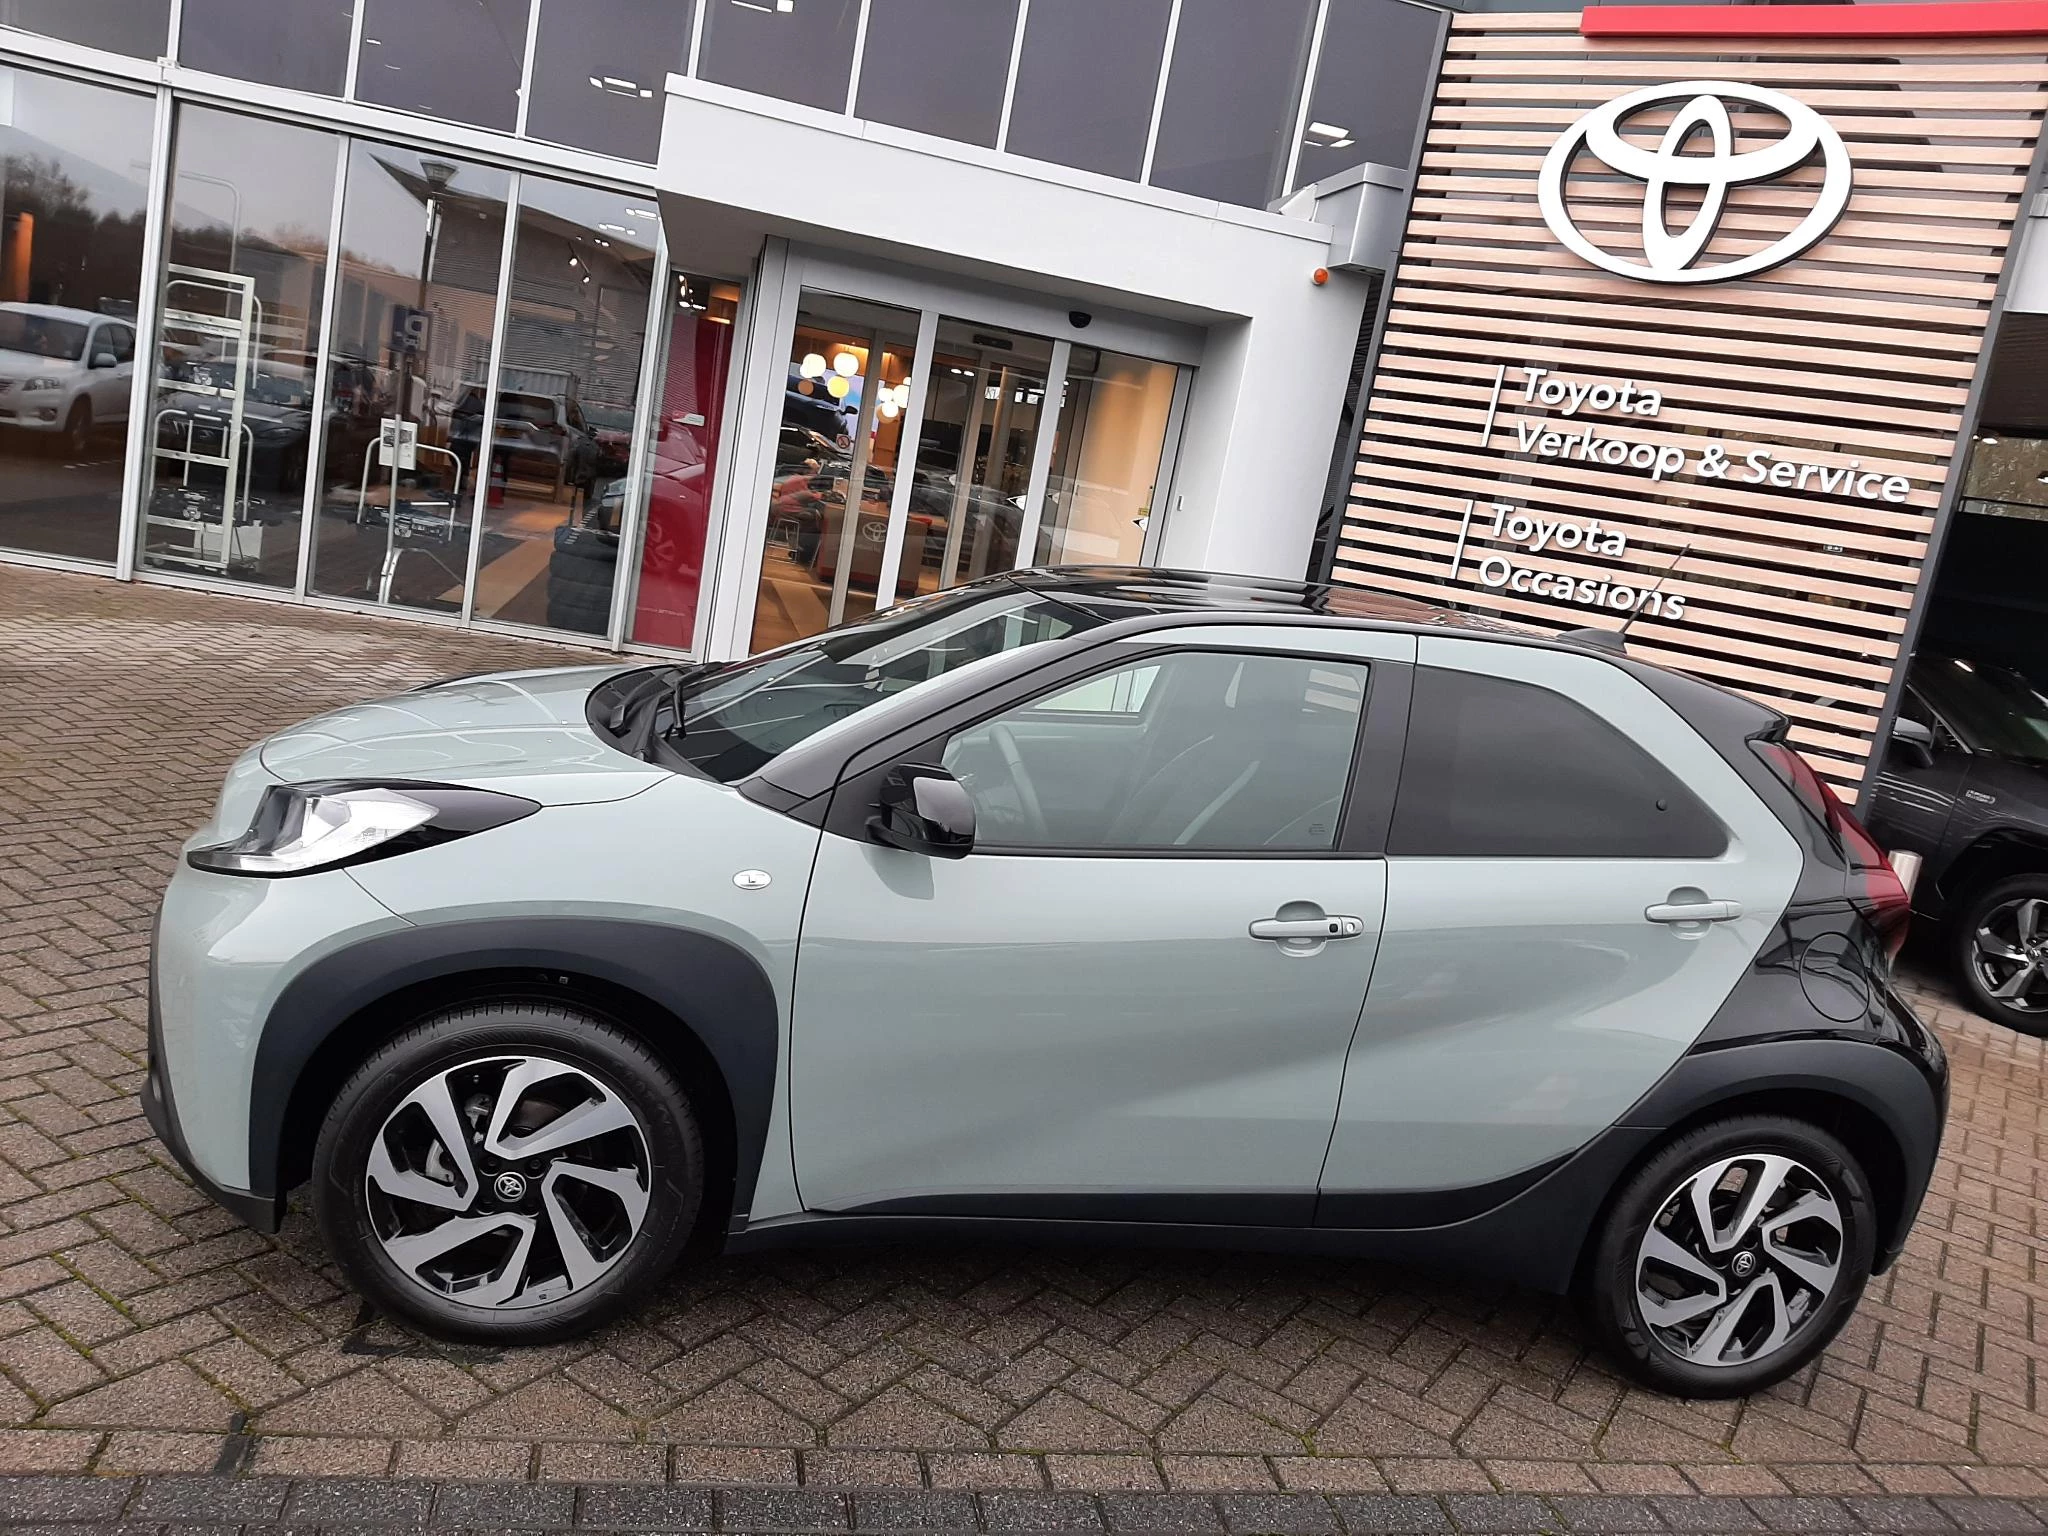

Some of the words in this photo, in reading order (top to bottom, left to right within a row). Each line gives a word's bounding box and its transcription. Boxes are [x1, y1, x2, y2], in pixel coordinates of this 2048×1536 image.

[1523, 366, 1662, 416] Toyota
[1517, 420, 1686, 482] Verkoop
[1695, 444, 1731, 479] &
[1742, 449, 1911, 503] Service
[1490, 503, 1628, 557] Toyota
[1479, 555, 1686, 620] Occasions
